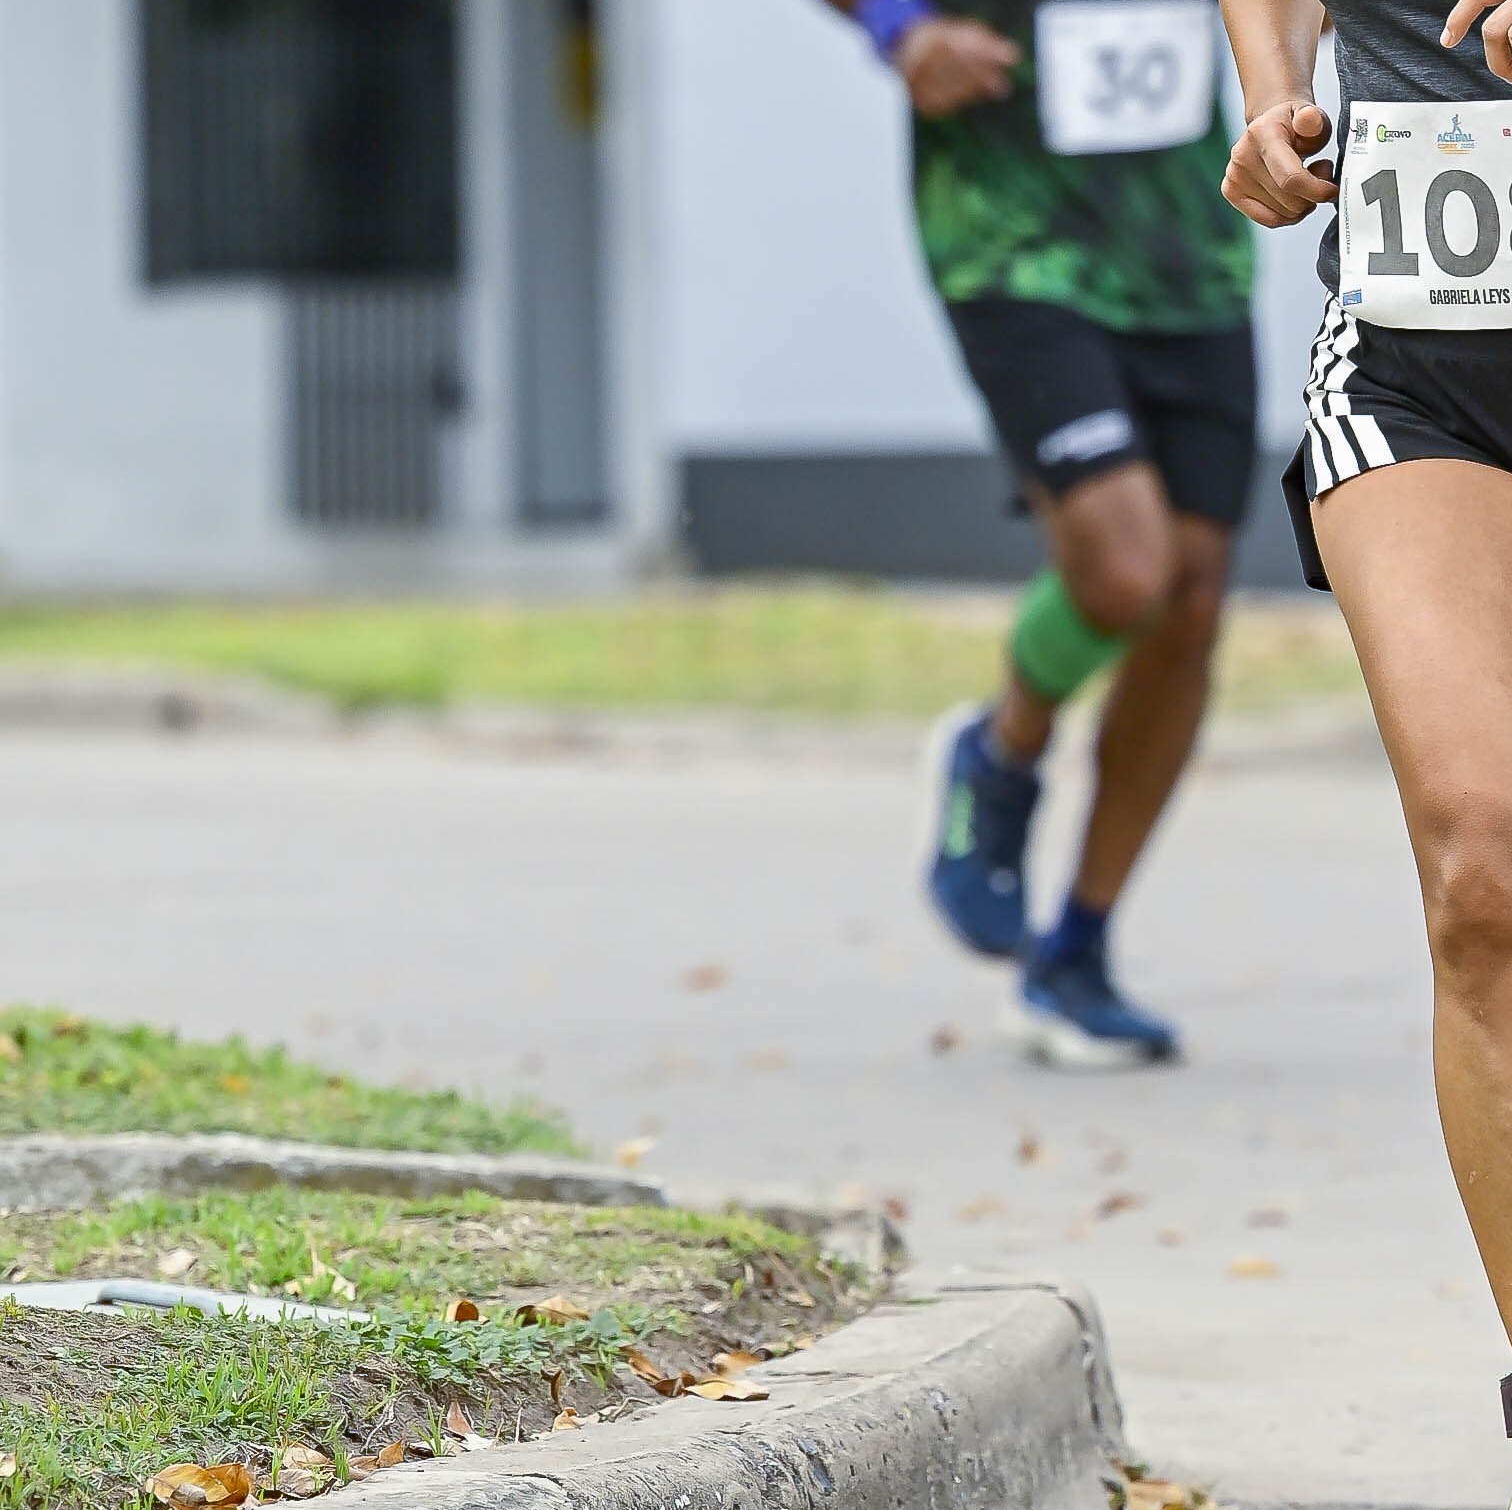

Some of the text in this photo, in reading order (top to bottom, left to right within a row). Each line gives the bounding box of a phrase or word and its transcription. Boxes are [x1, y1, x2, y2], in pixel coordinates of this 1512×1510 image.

[1085, 44, 1182, 115] 30
[1429, 289, 1511, 305] GABRIELA LEYS
